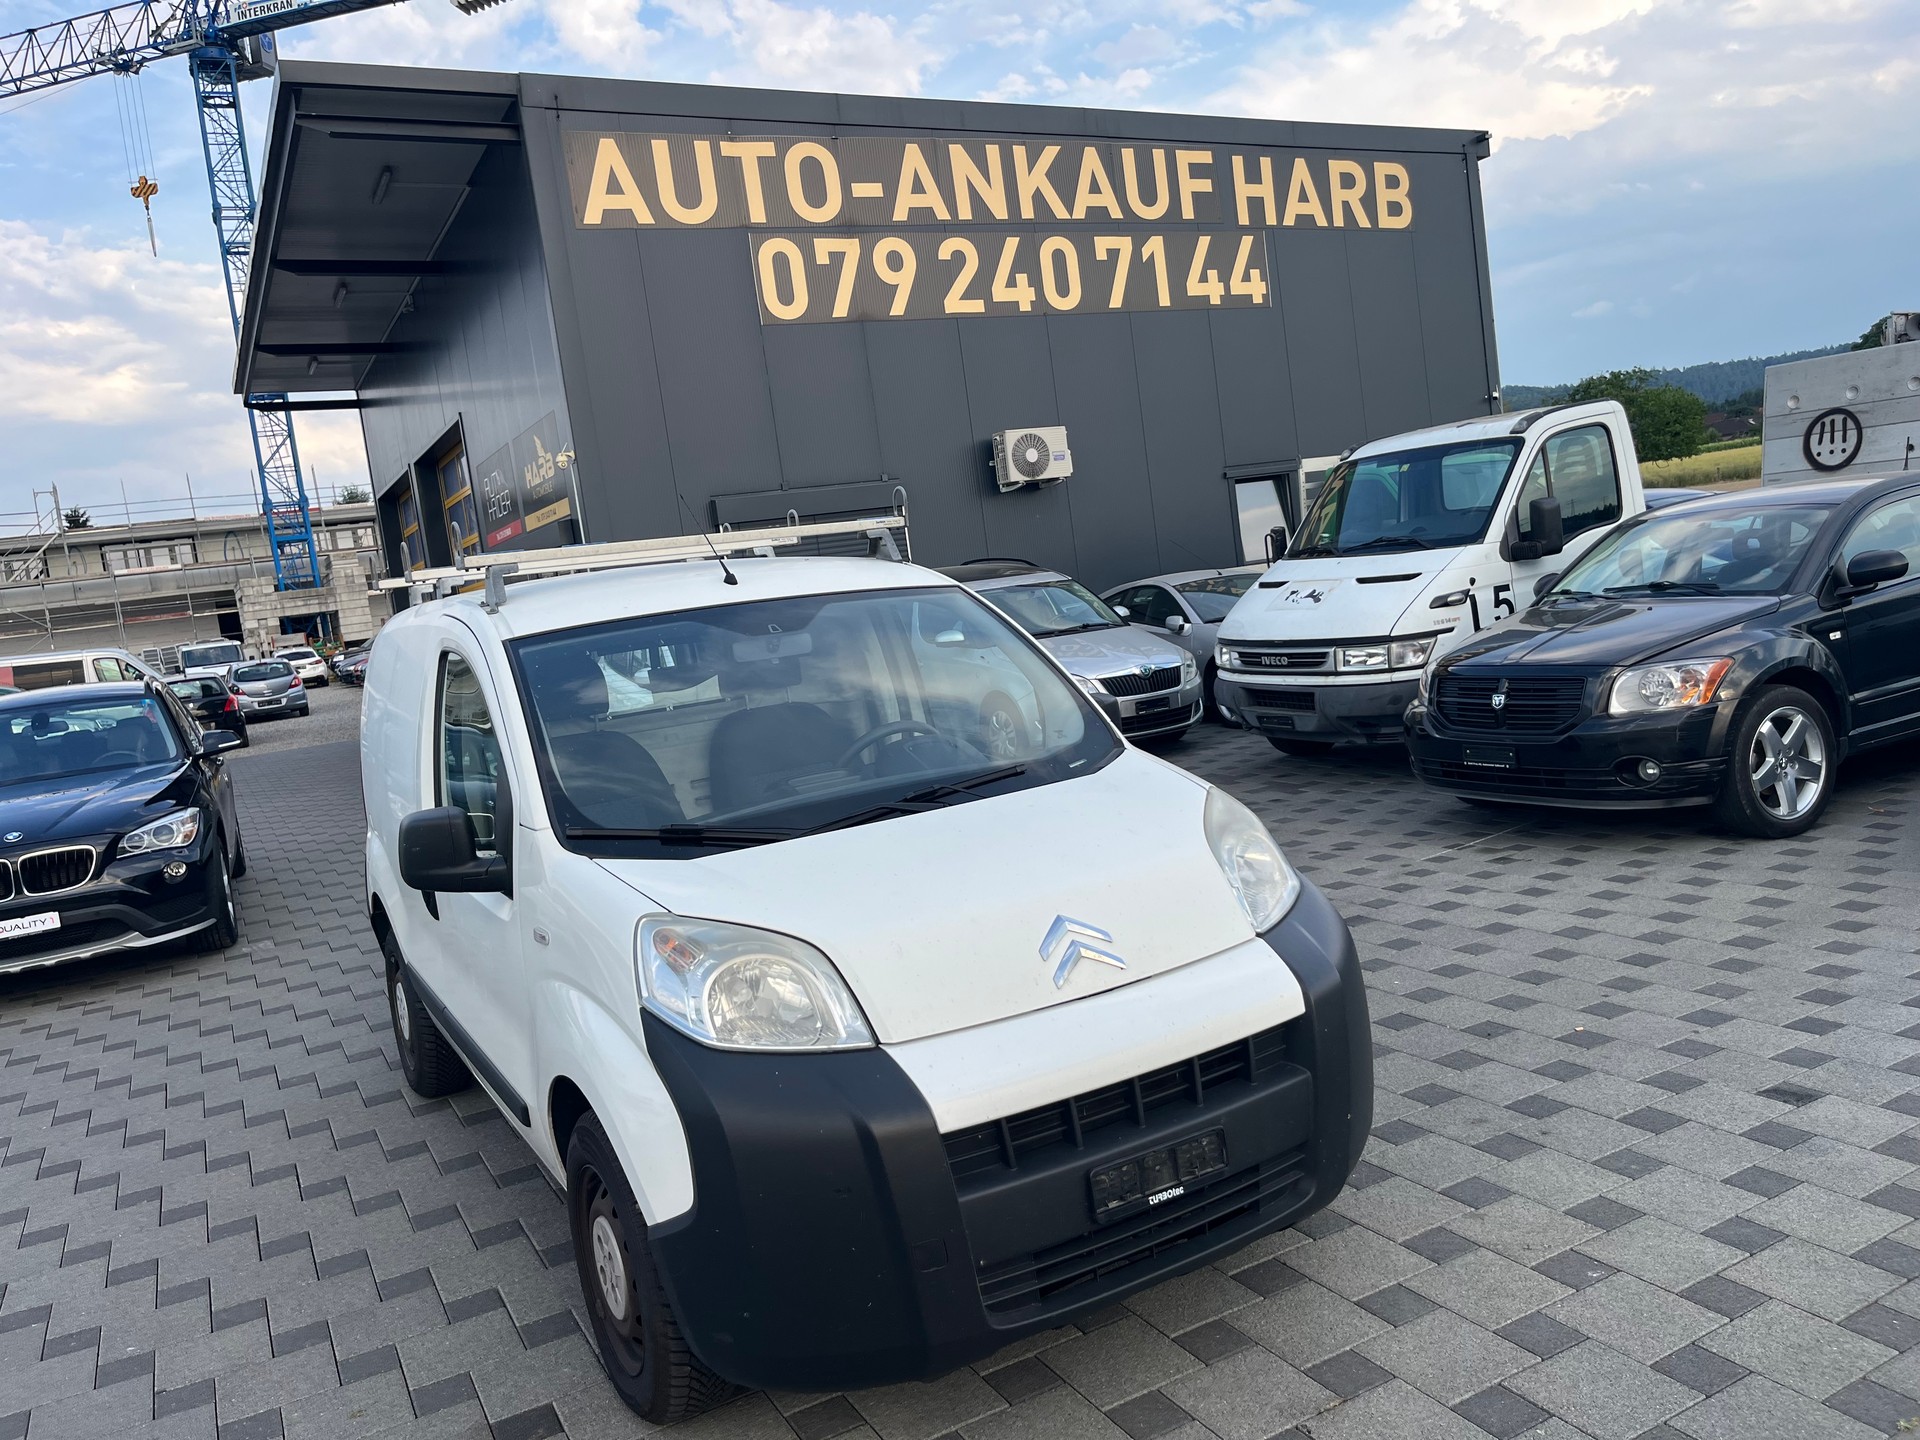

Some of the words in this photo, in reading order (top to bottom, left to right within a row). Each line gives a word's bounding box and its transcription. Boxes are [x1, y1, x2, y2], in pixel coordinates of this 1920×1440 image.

[237, 0, 293, 21] INTERKRAN
[583, 138, 1213, 225] AUTO-ANKAUF
[1231, 155, 1413, 229] HARB
[524, 452, 555, 489] HARB
[1261, 656, 1288, 665] IVECO
